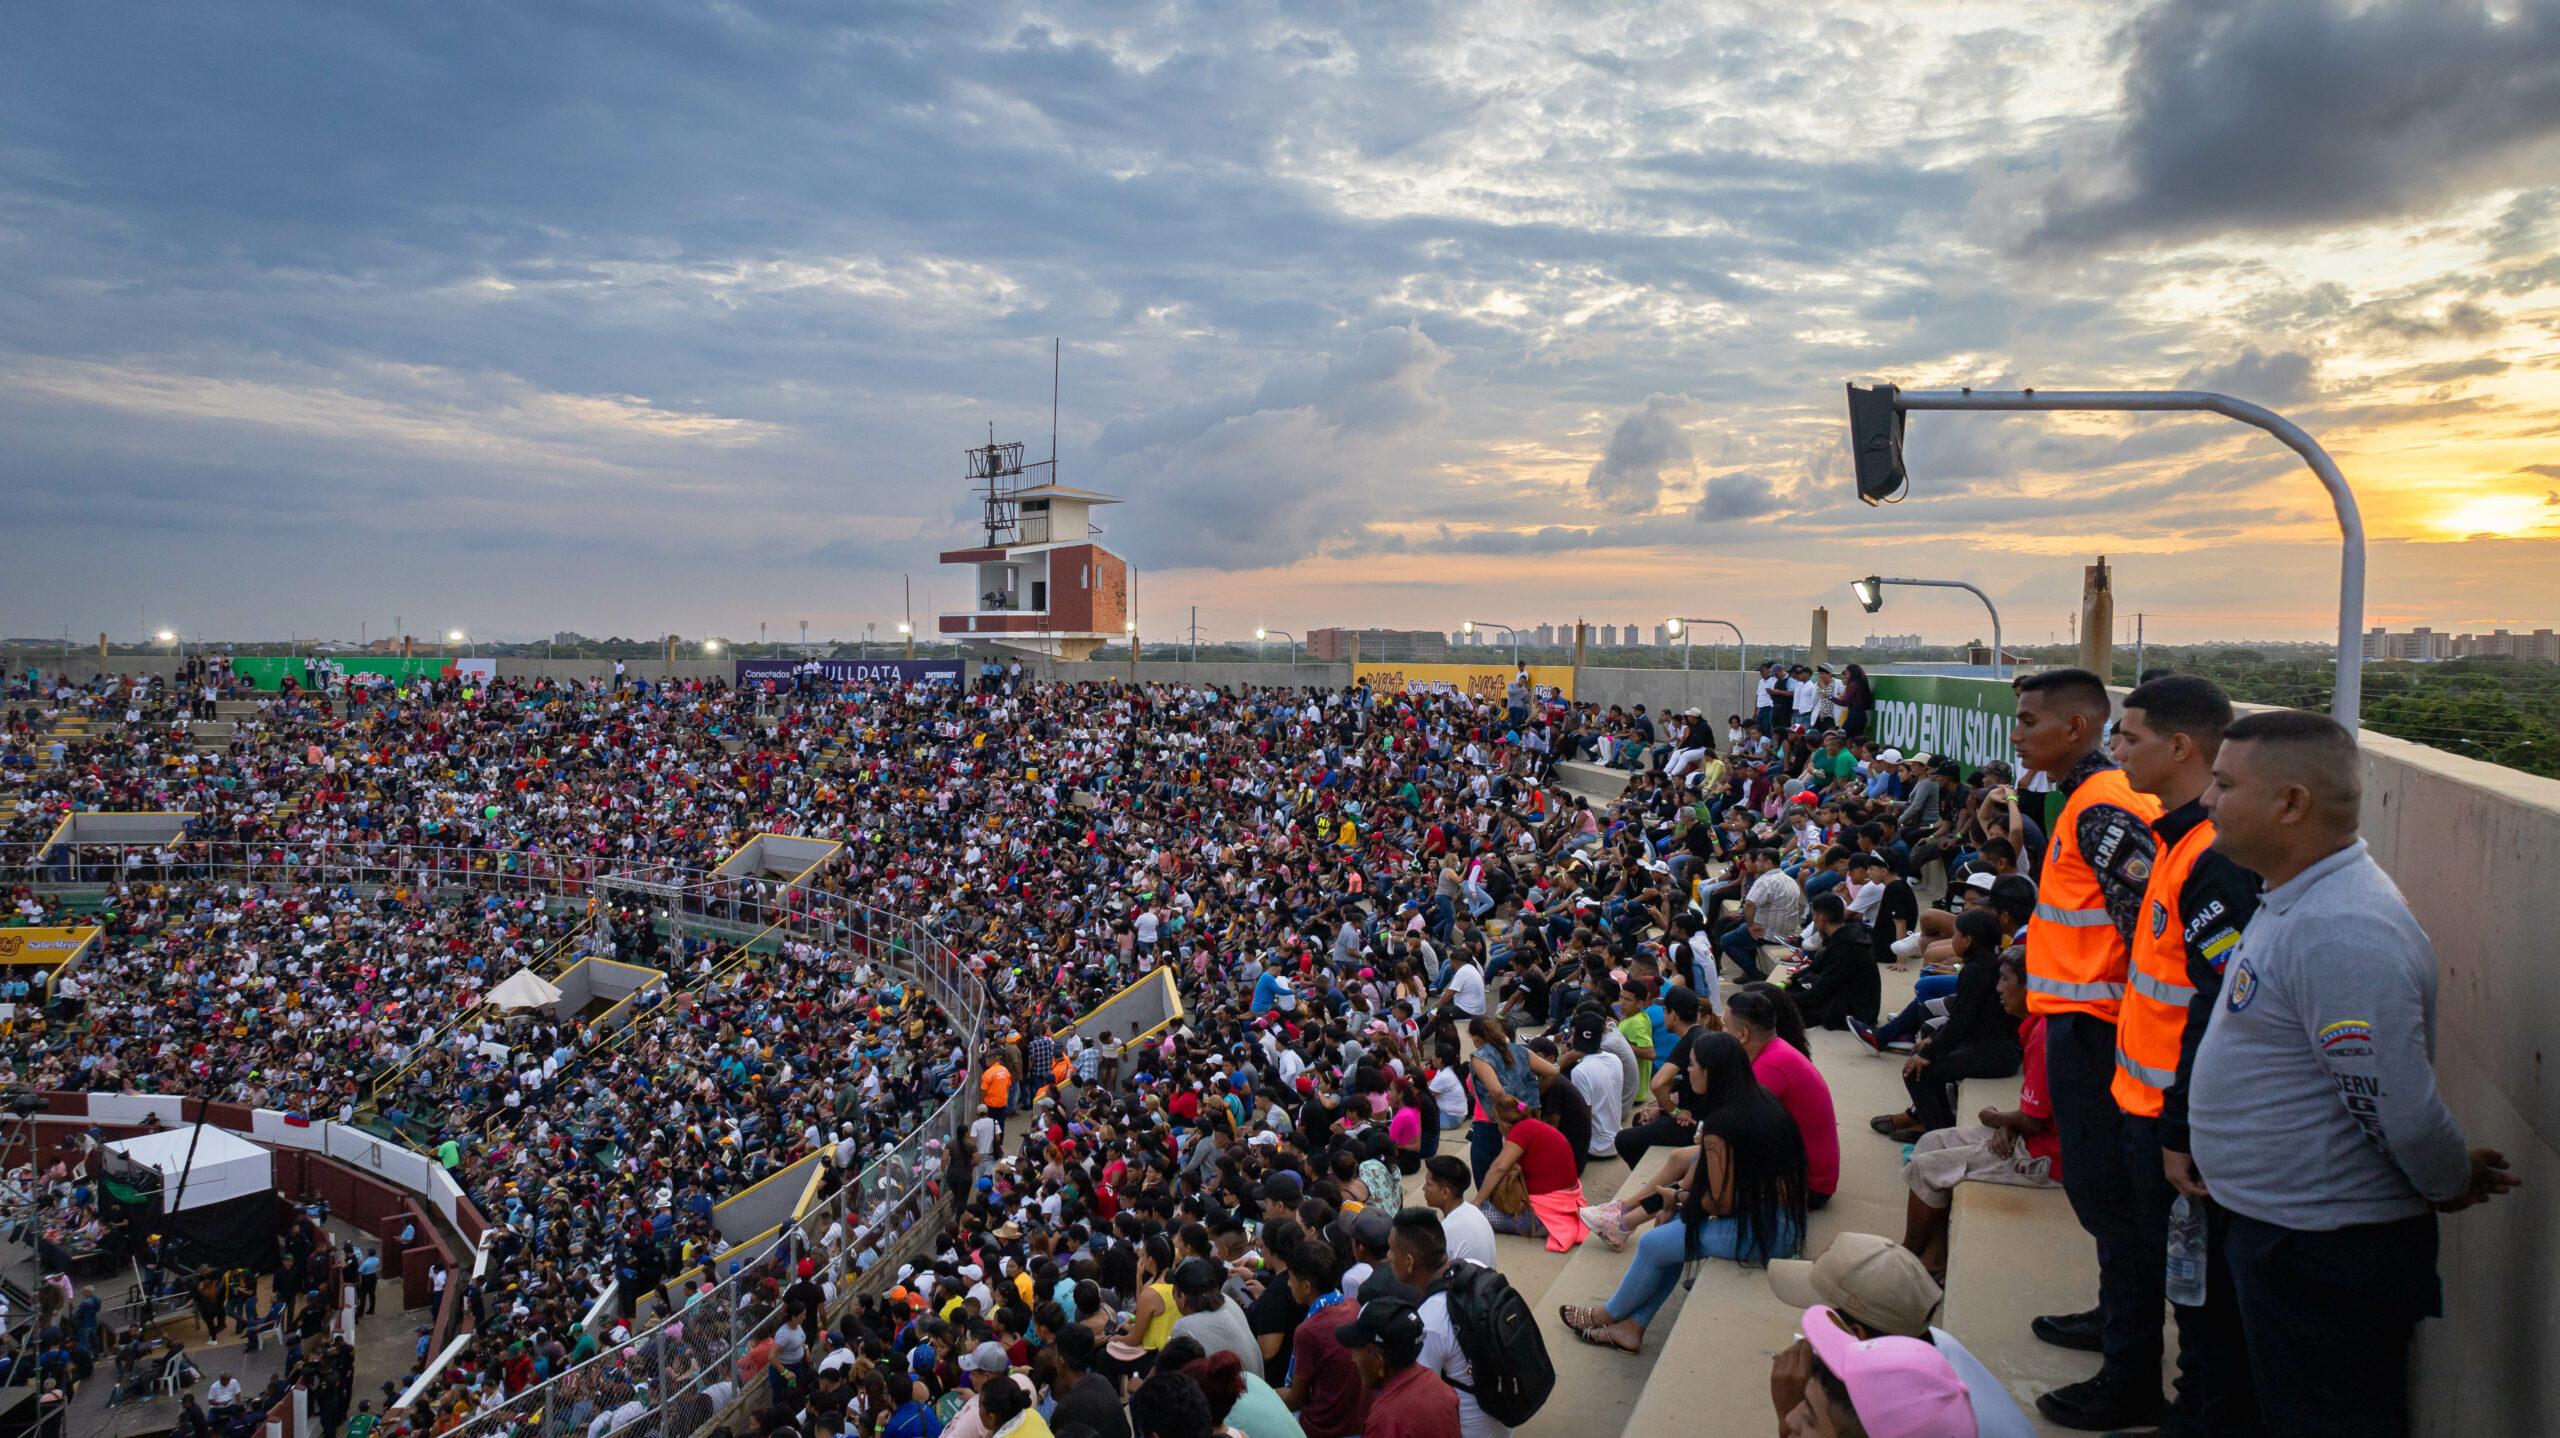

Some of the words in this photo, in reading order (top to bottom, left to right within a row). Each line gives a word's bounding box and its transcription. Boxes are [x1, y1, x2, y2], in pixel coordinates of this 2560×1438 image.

[745, 669, 791, 678] Conectados
[1875, 699, 1917, 750] TODO
[1919, 703, 1942, 755] EN
[1943, 705, 1963, 762] UN
[1964, 692, 2002, 768] SÓLO
[2094, 824, 2125, 868] C.P.N.B
[2184, 900, 2224, 942] C.P.N.B
[28, 940, 52, 951] Sabe
[2198, 926, 2236, 950] Venezuela
[2327, 1047, 2374, 1057] VENEZUELA
[2332, 1071, 2387, 1098] SERV.
